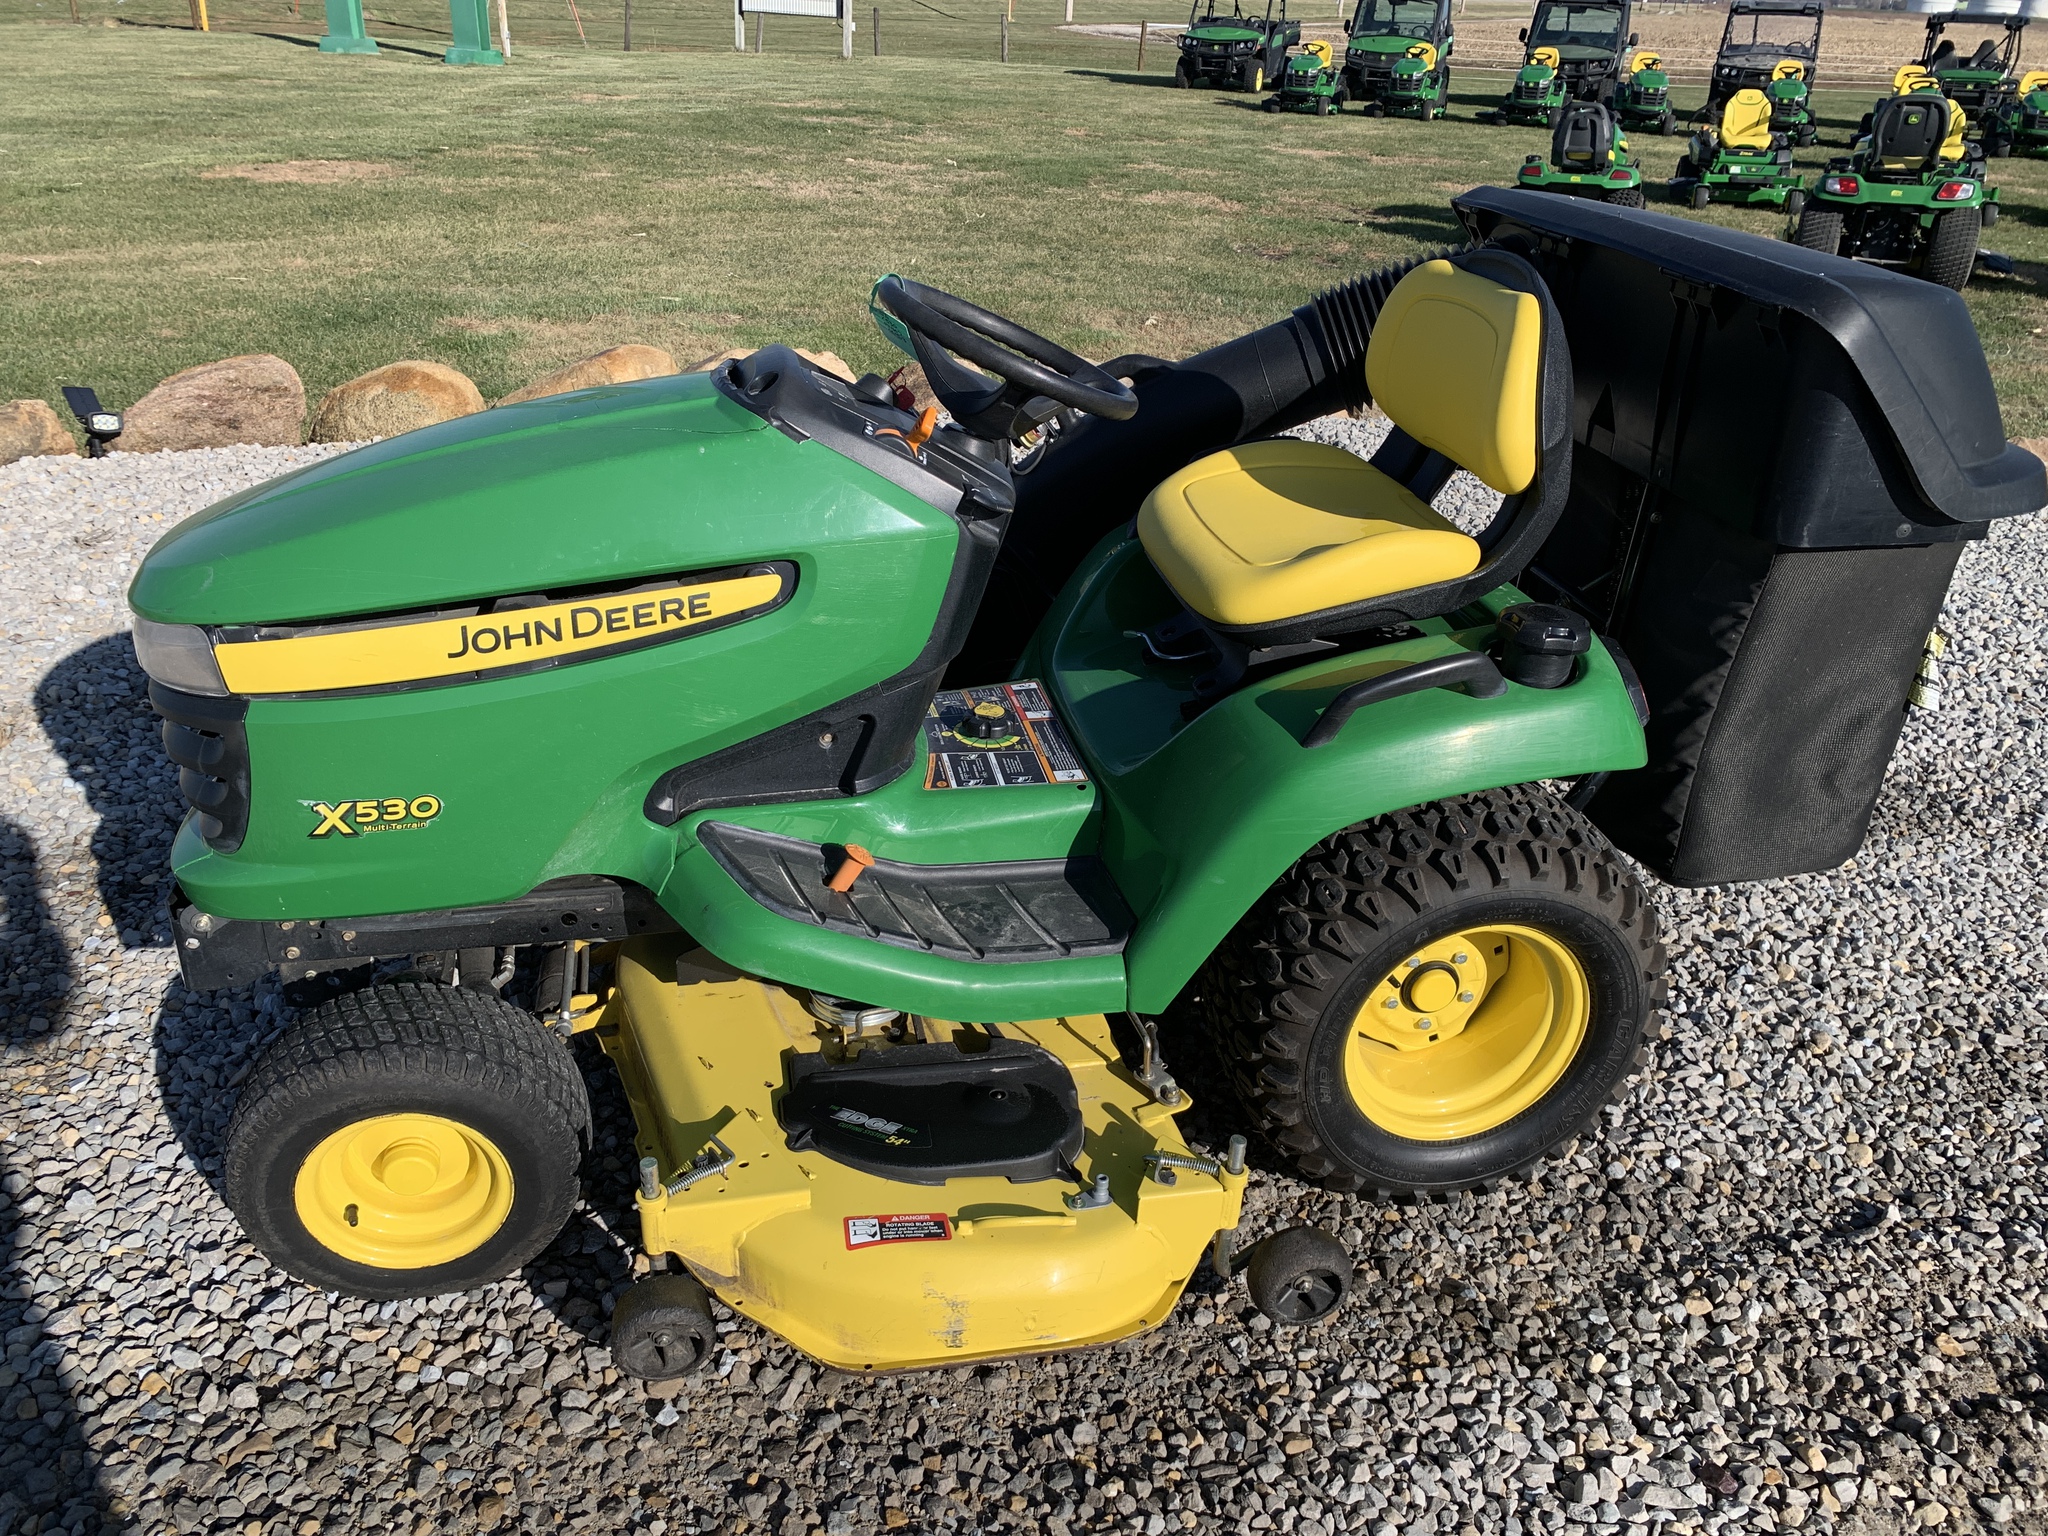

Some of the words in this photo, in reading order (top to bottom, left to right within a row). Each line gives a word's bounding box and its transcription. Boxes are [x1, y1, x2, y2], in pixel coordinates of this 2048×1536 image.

[447, 616, 563, 659] JOHN
[570, 591, 712, 639] DEERE
[308, 795, 442, 839] X530
[363, 821, 427, 833] Multi-Terrain
[829, 1107, 904, 1135] EDGE
[837, 1121, 863, 1133] CUTTING
[862, 1129, 888, 1140] SYSTEM
[885, 1135, 912, 1146] 54"
